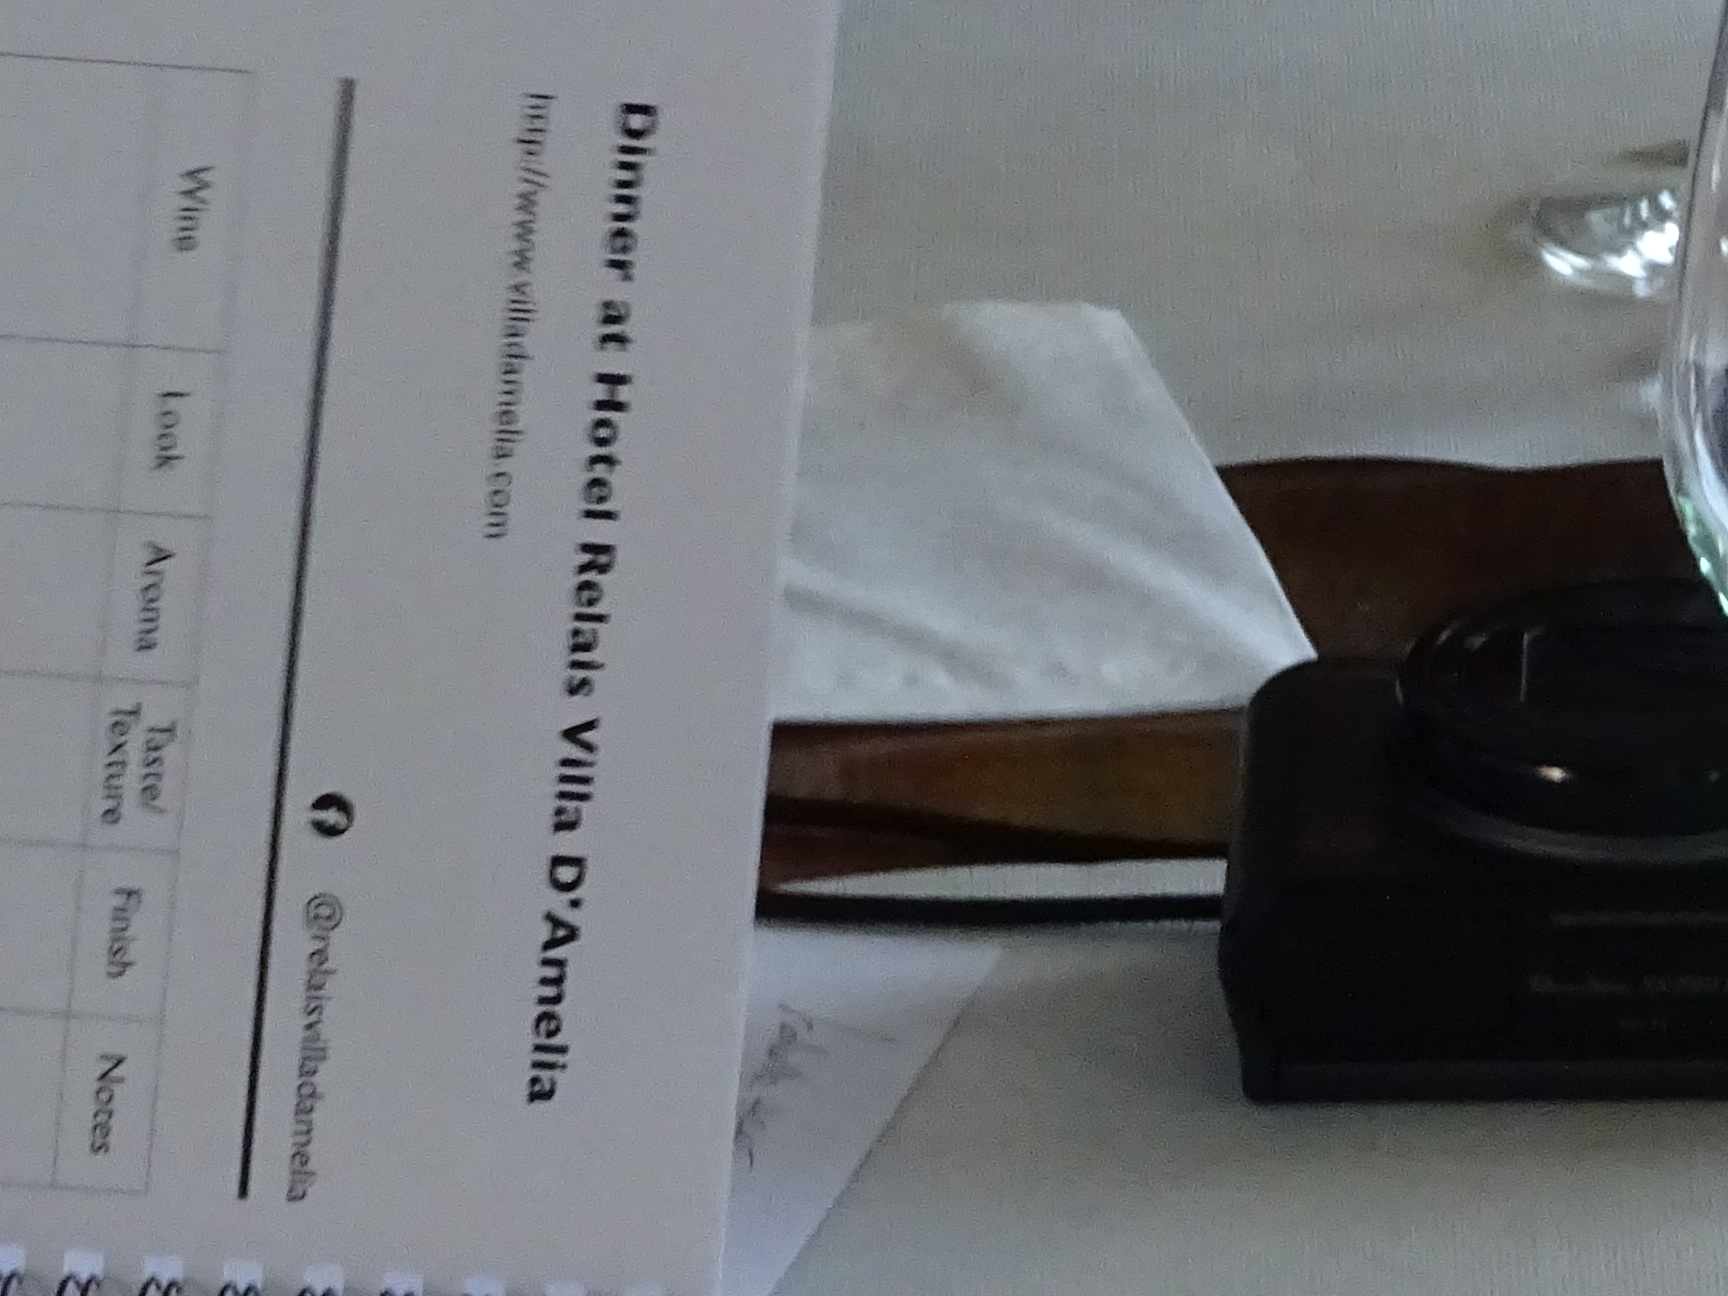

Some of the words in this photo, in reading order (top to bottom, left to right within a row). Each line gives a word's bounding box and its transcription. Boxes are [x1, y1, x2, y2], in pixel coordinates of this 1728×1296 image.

[172, 164, 214, 254] Wine
[603, 102, 659, 283] Dinner
[596, 300, 638, 353] at
[148, 389, 193, 471] Look
[580, 371, 634, 523] Hotel
[132, 540, 177, 653] Aroma
[564, 541, 620, 700] Relais
[99, 701, 142, 827] Texture
[550, 715, 603, 836] Villa
[106, 884, 144, 981] Finish
[526, 852, 589, 1105] D'Amelia
[88, 1051, 129, 1157] Notes
